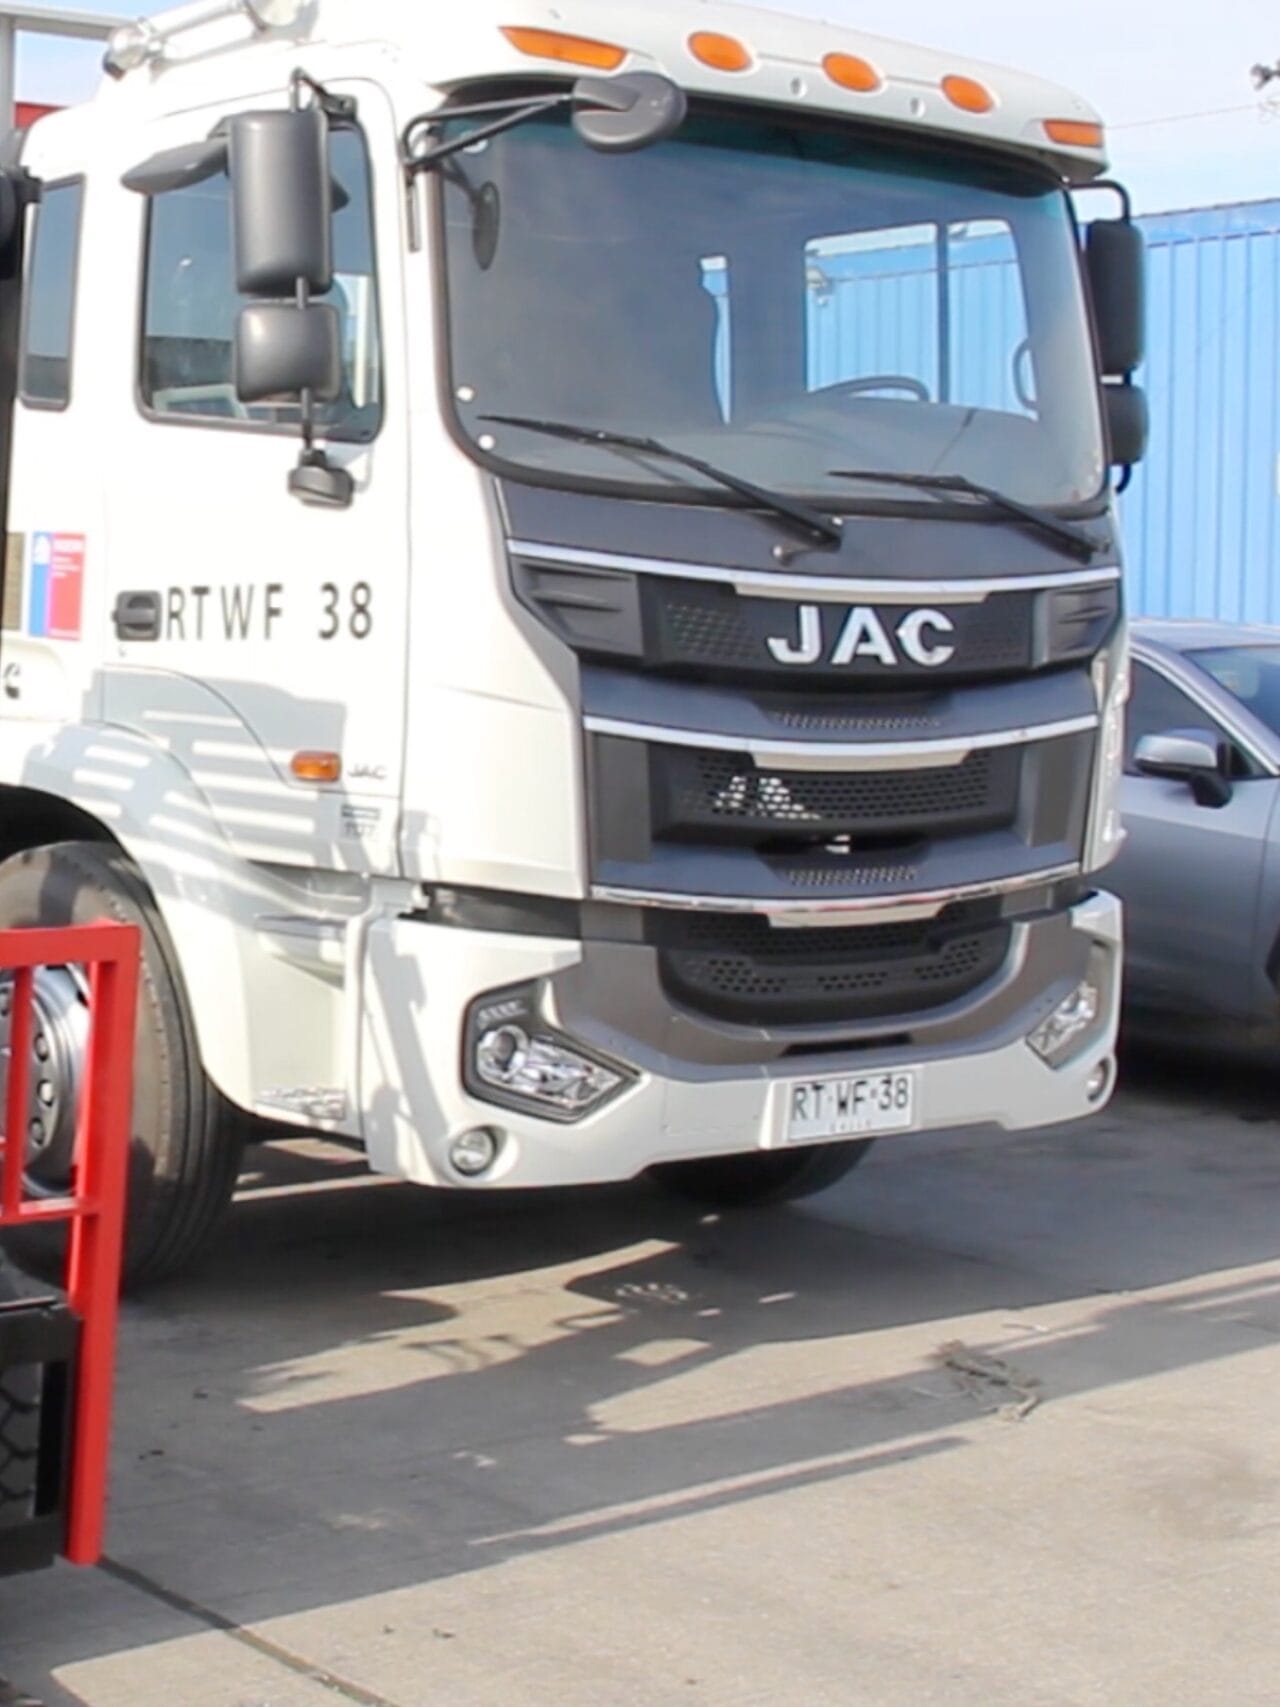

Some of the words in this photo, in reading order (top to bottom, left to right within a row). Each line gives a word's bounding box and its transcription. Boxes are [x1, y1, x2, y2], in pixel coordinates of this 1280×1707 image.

[166, 583, 283, 641] RTWF
[318, 582, 373, 640] 38
[767, 605, 955, 667] JAC
